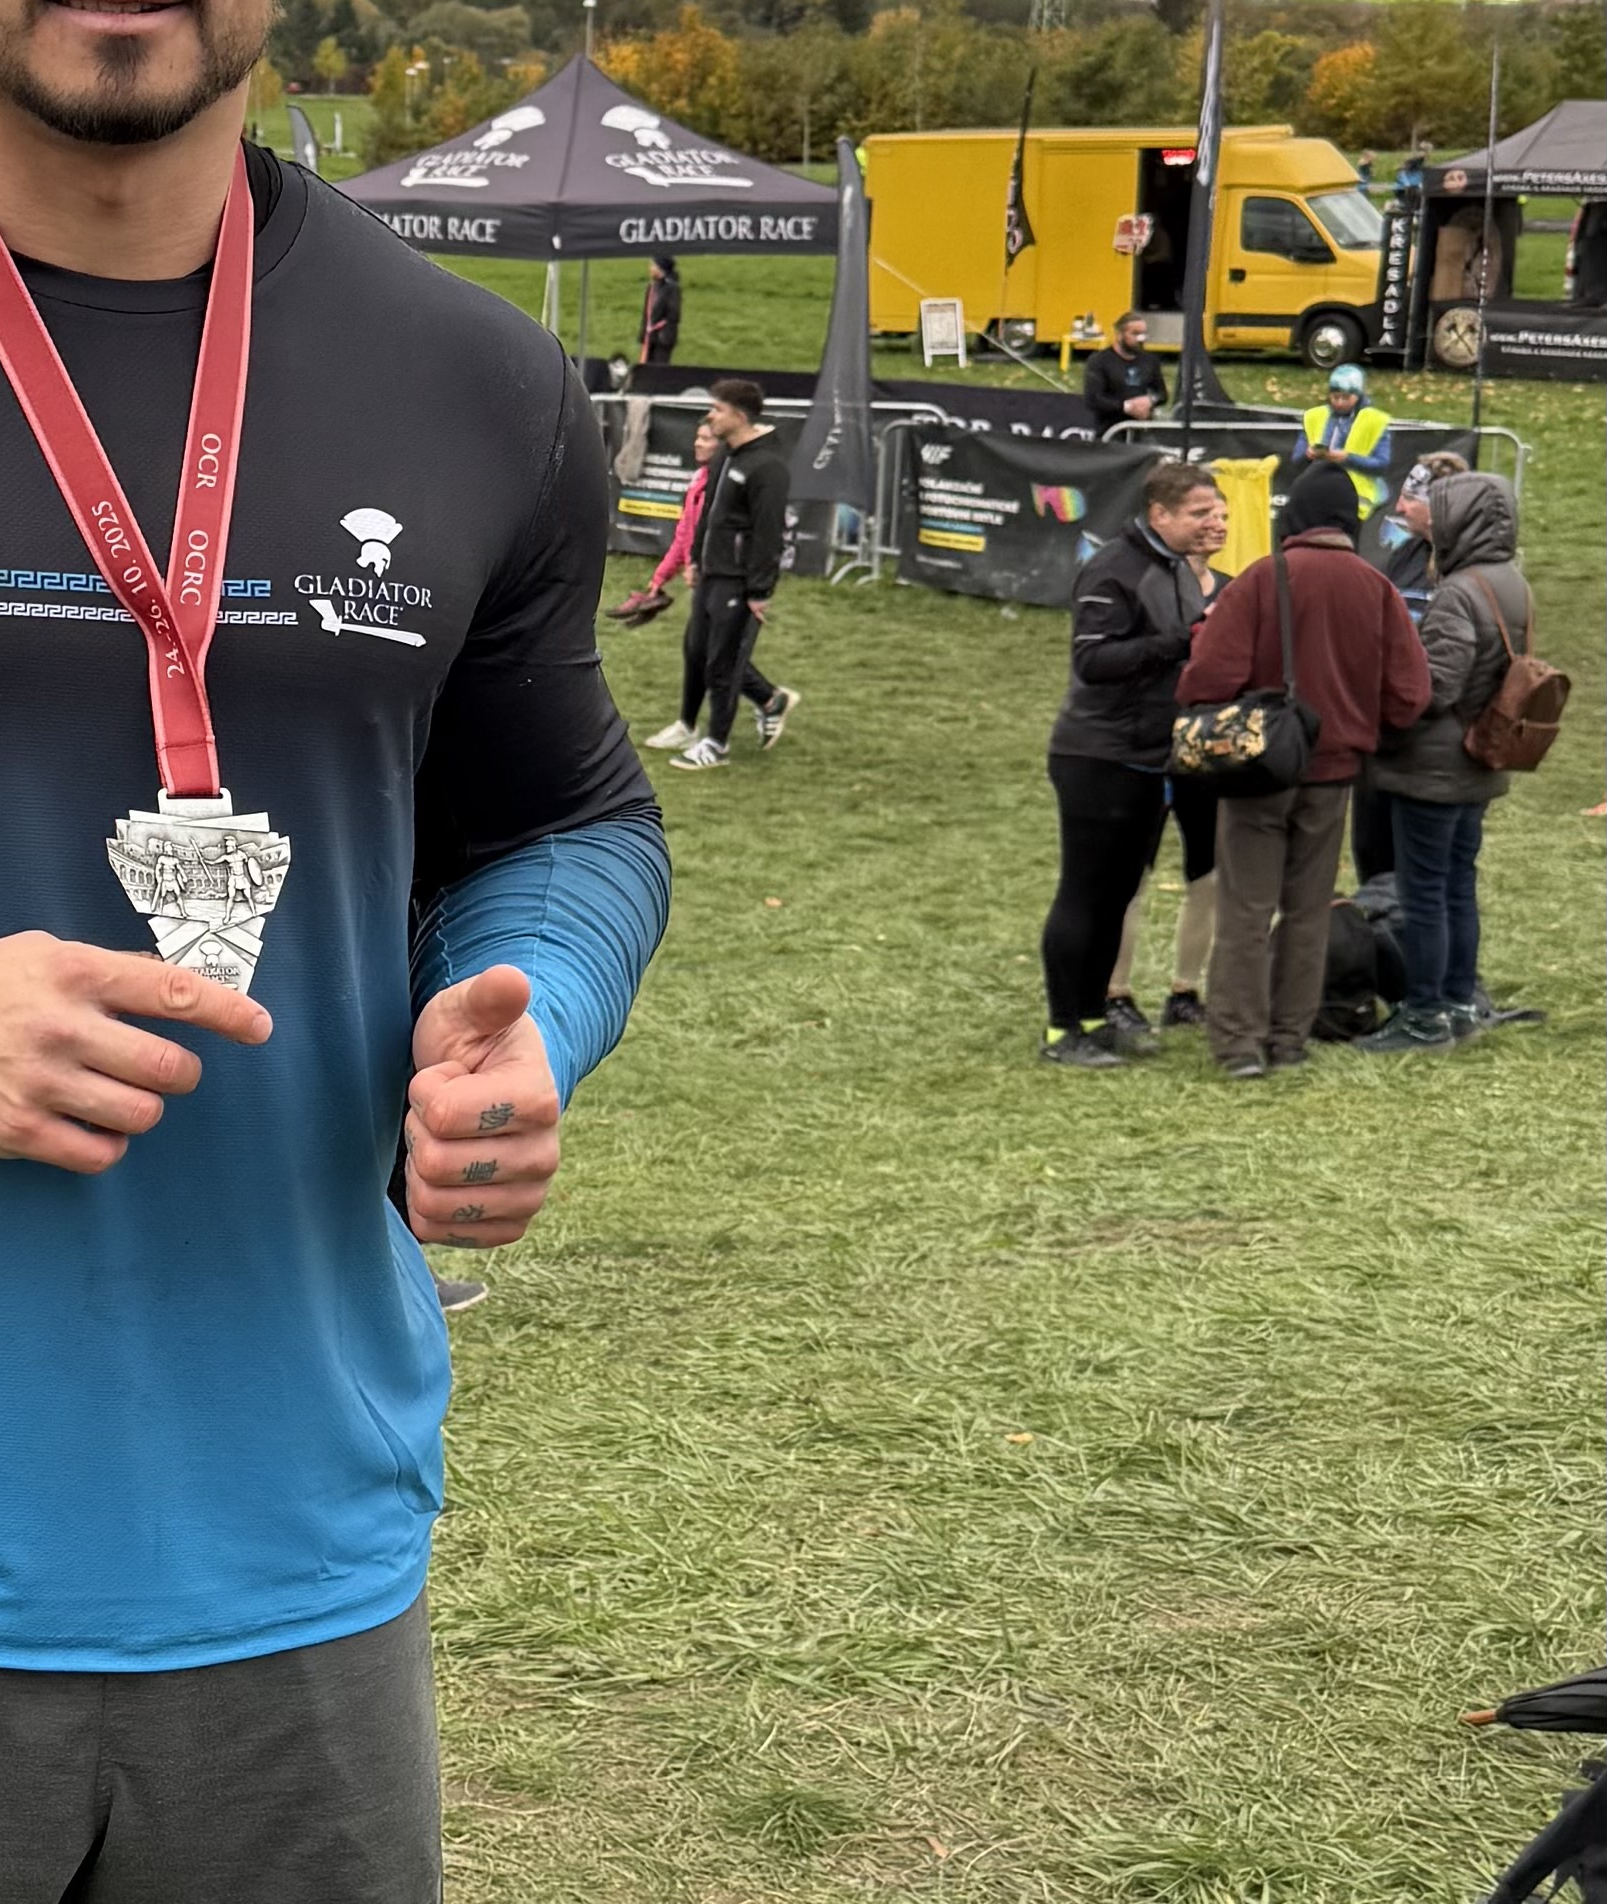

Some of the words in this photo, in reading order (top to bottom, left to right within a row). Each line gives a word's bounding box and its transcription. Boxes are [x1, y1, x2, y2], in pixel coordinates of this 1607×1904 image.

[416, 150, 530, 168] GLADIATOR
[605, 150, 739, 169] GLADIATOR
[448, 217, 499, 243] RACE
[619, 216, 757, 244] GLADIATOR
[760, 217, 814, 241] RACE
[195, 432, 222, 489] OCR
[91, 500, 132, 559] 2025
[123, 559, 148, 595] 10.
[179, 529, 209, 606] OCRC
[294, 574, 433, 608] GLADIATOR
[344, 600, 399, 626] RACE
